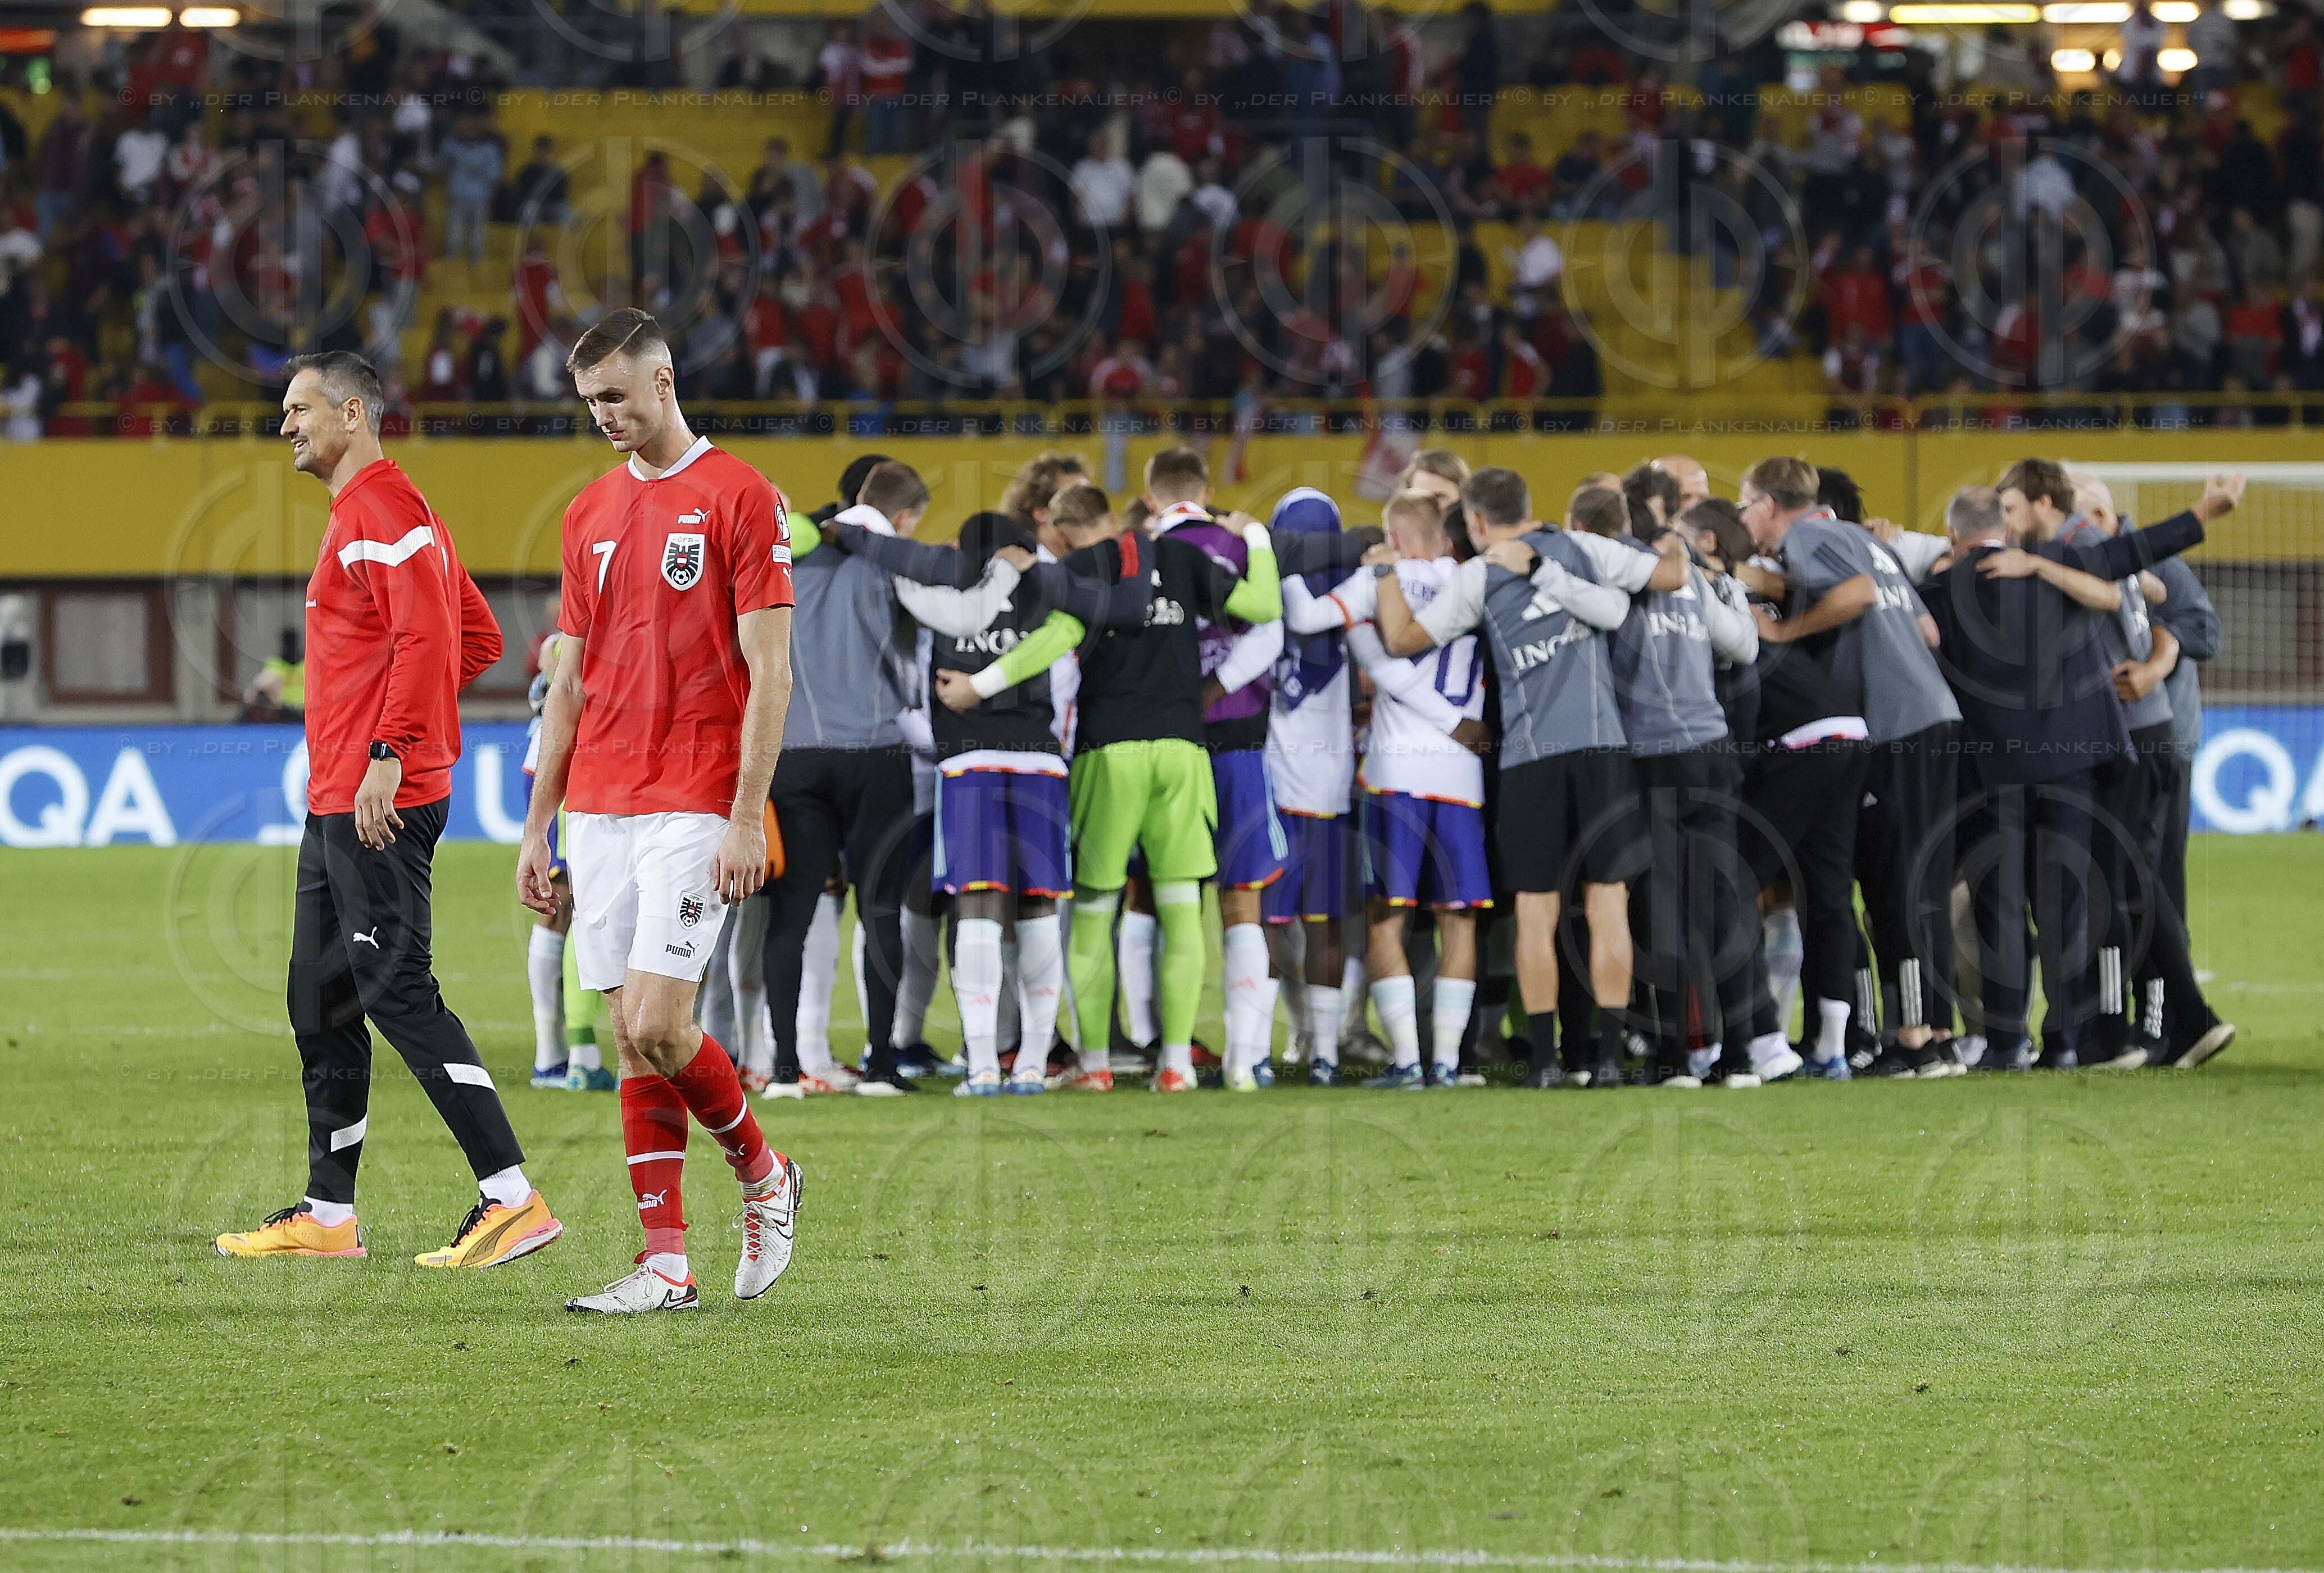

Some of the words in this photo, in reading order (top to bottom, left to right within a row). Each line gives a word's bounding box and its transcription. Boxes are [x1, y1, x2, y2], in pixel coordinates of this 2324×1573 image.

[592, 539, 617, 595] 7
[2190, 726, 2324, 836] Q
[665, 944, 692, 959] PUMA
